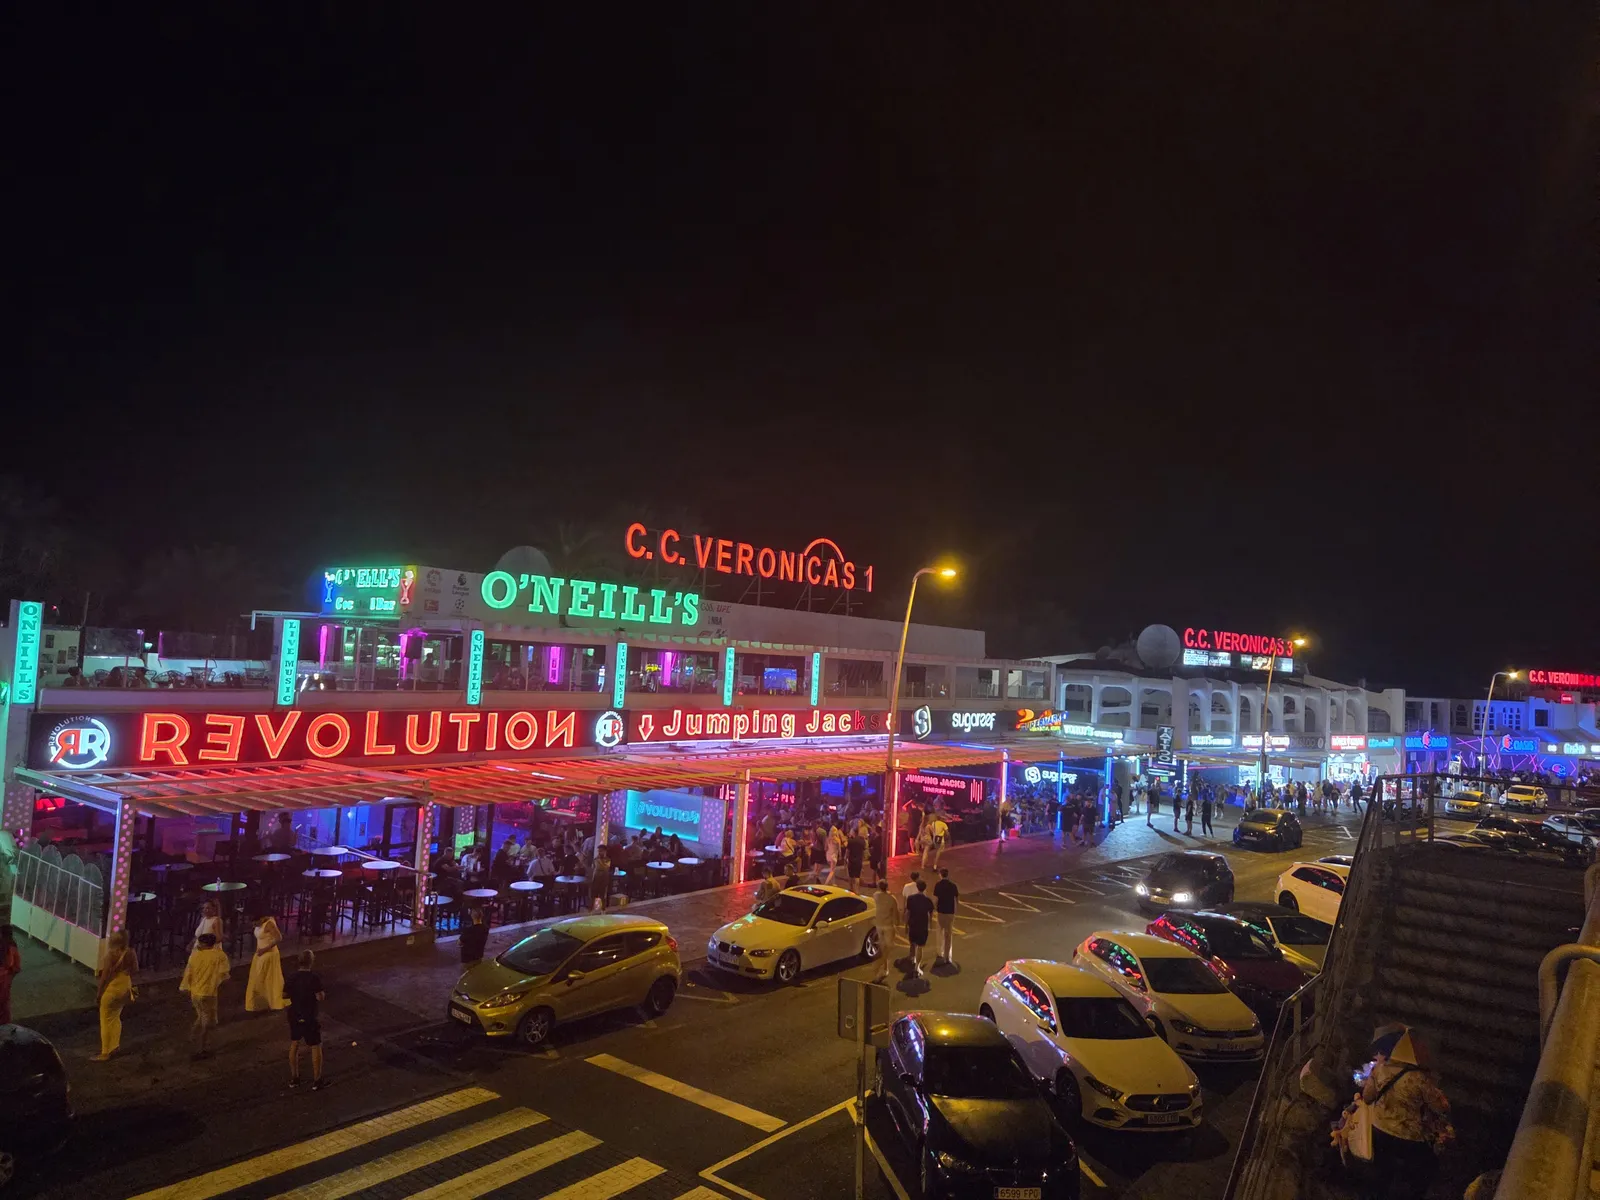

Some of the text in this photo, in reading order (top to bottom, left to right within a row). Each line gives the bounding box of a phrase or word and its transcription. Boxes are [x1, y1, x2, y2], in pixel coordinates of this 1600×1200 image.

[694, 534, 855, 590] VERONICAS
[864, 565, 873, 592] 1
[481, 570, 699, 626] O'NEILL'S
[1184, 628, 1293, 657] C.C. VERONICAS 3
[282, 621, 297, 702] LIVE MUSIC
[1529, 670, 1547, 682] C.C.
[138, 710, 577, 764] REVOLUTION
[663, 709, 881, 741] Jumping Jacks
[905, 774, 966, 789] JUMPING JACKS
[1000, 1188, 1020, 1198] 6599
